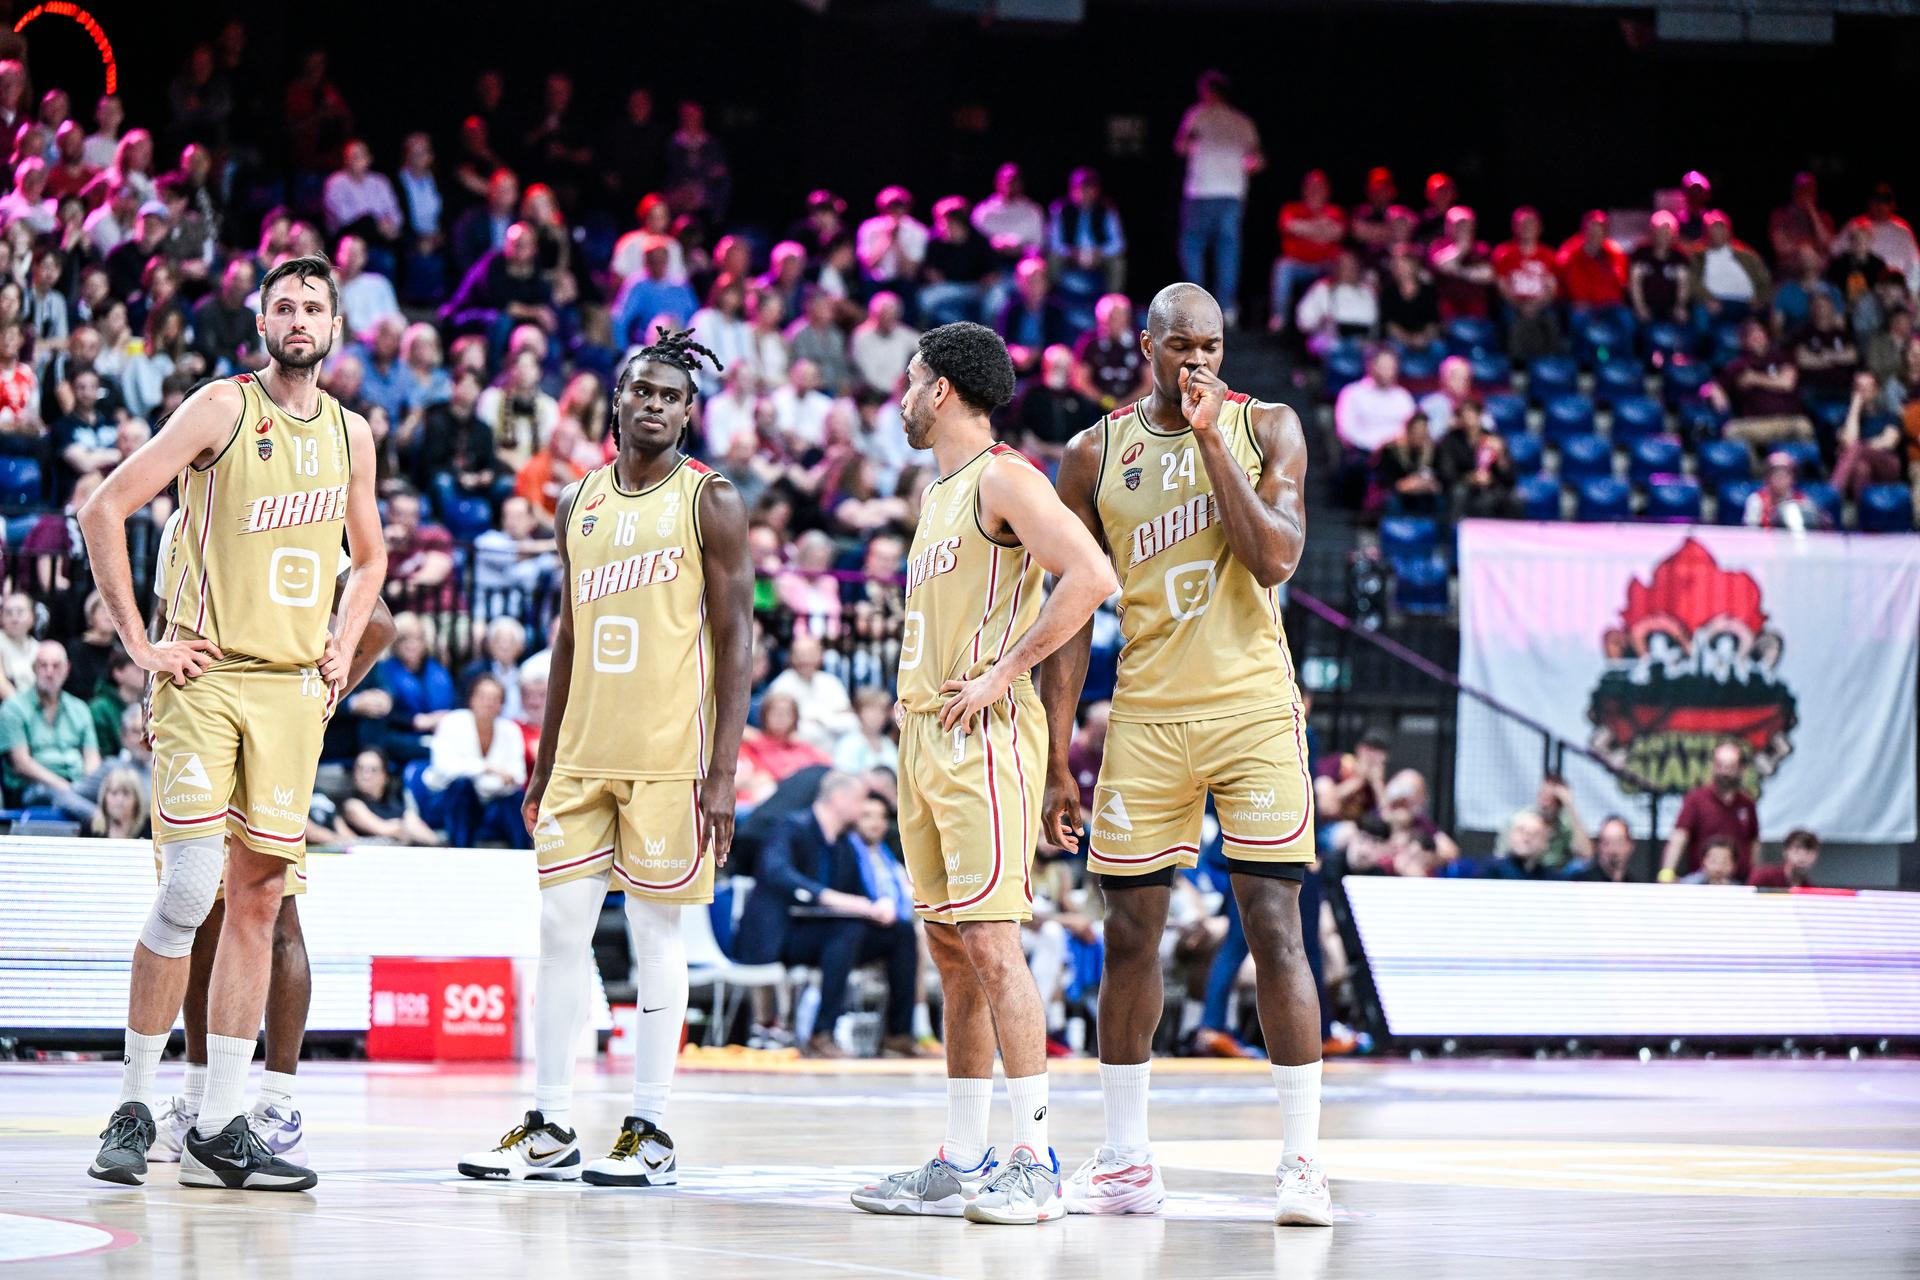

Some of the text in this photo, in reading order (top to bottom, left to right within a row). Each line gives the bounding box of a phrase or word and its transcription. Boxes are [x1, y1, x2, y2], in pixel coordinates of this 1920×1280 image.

[292, 435, 319, 477] 13
[1160, 447, 1196, 491] 24
[614, 511, 639, 546] 16
[577, 546, 685, 605] GIANTS
[953, 725, 966, 763] 9
[165, 793, 212, 805] aertssen
[1232, 810, 1299, 822] WINDROSE
[443, 983, 506, 1021] SOS
